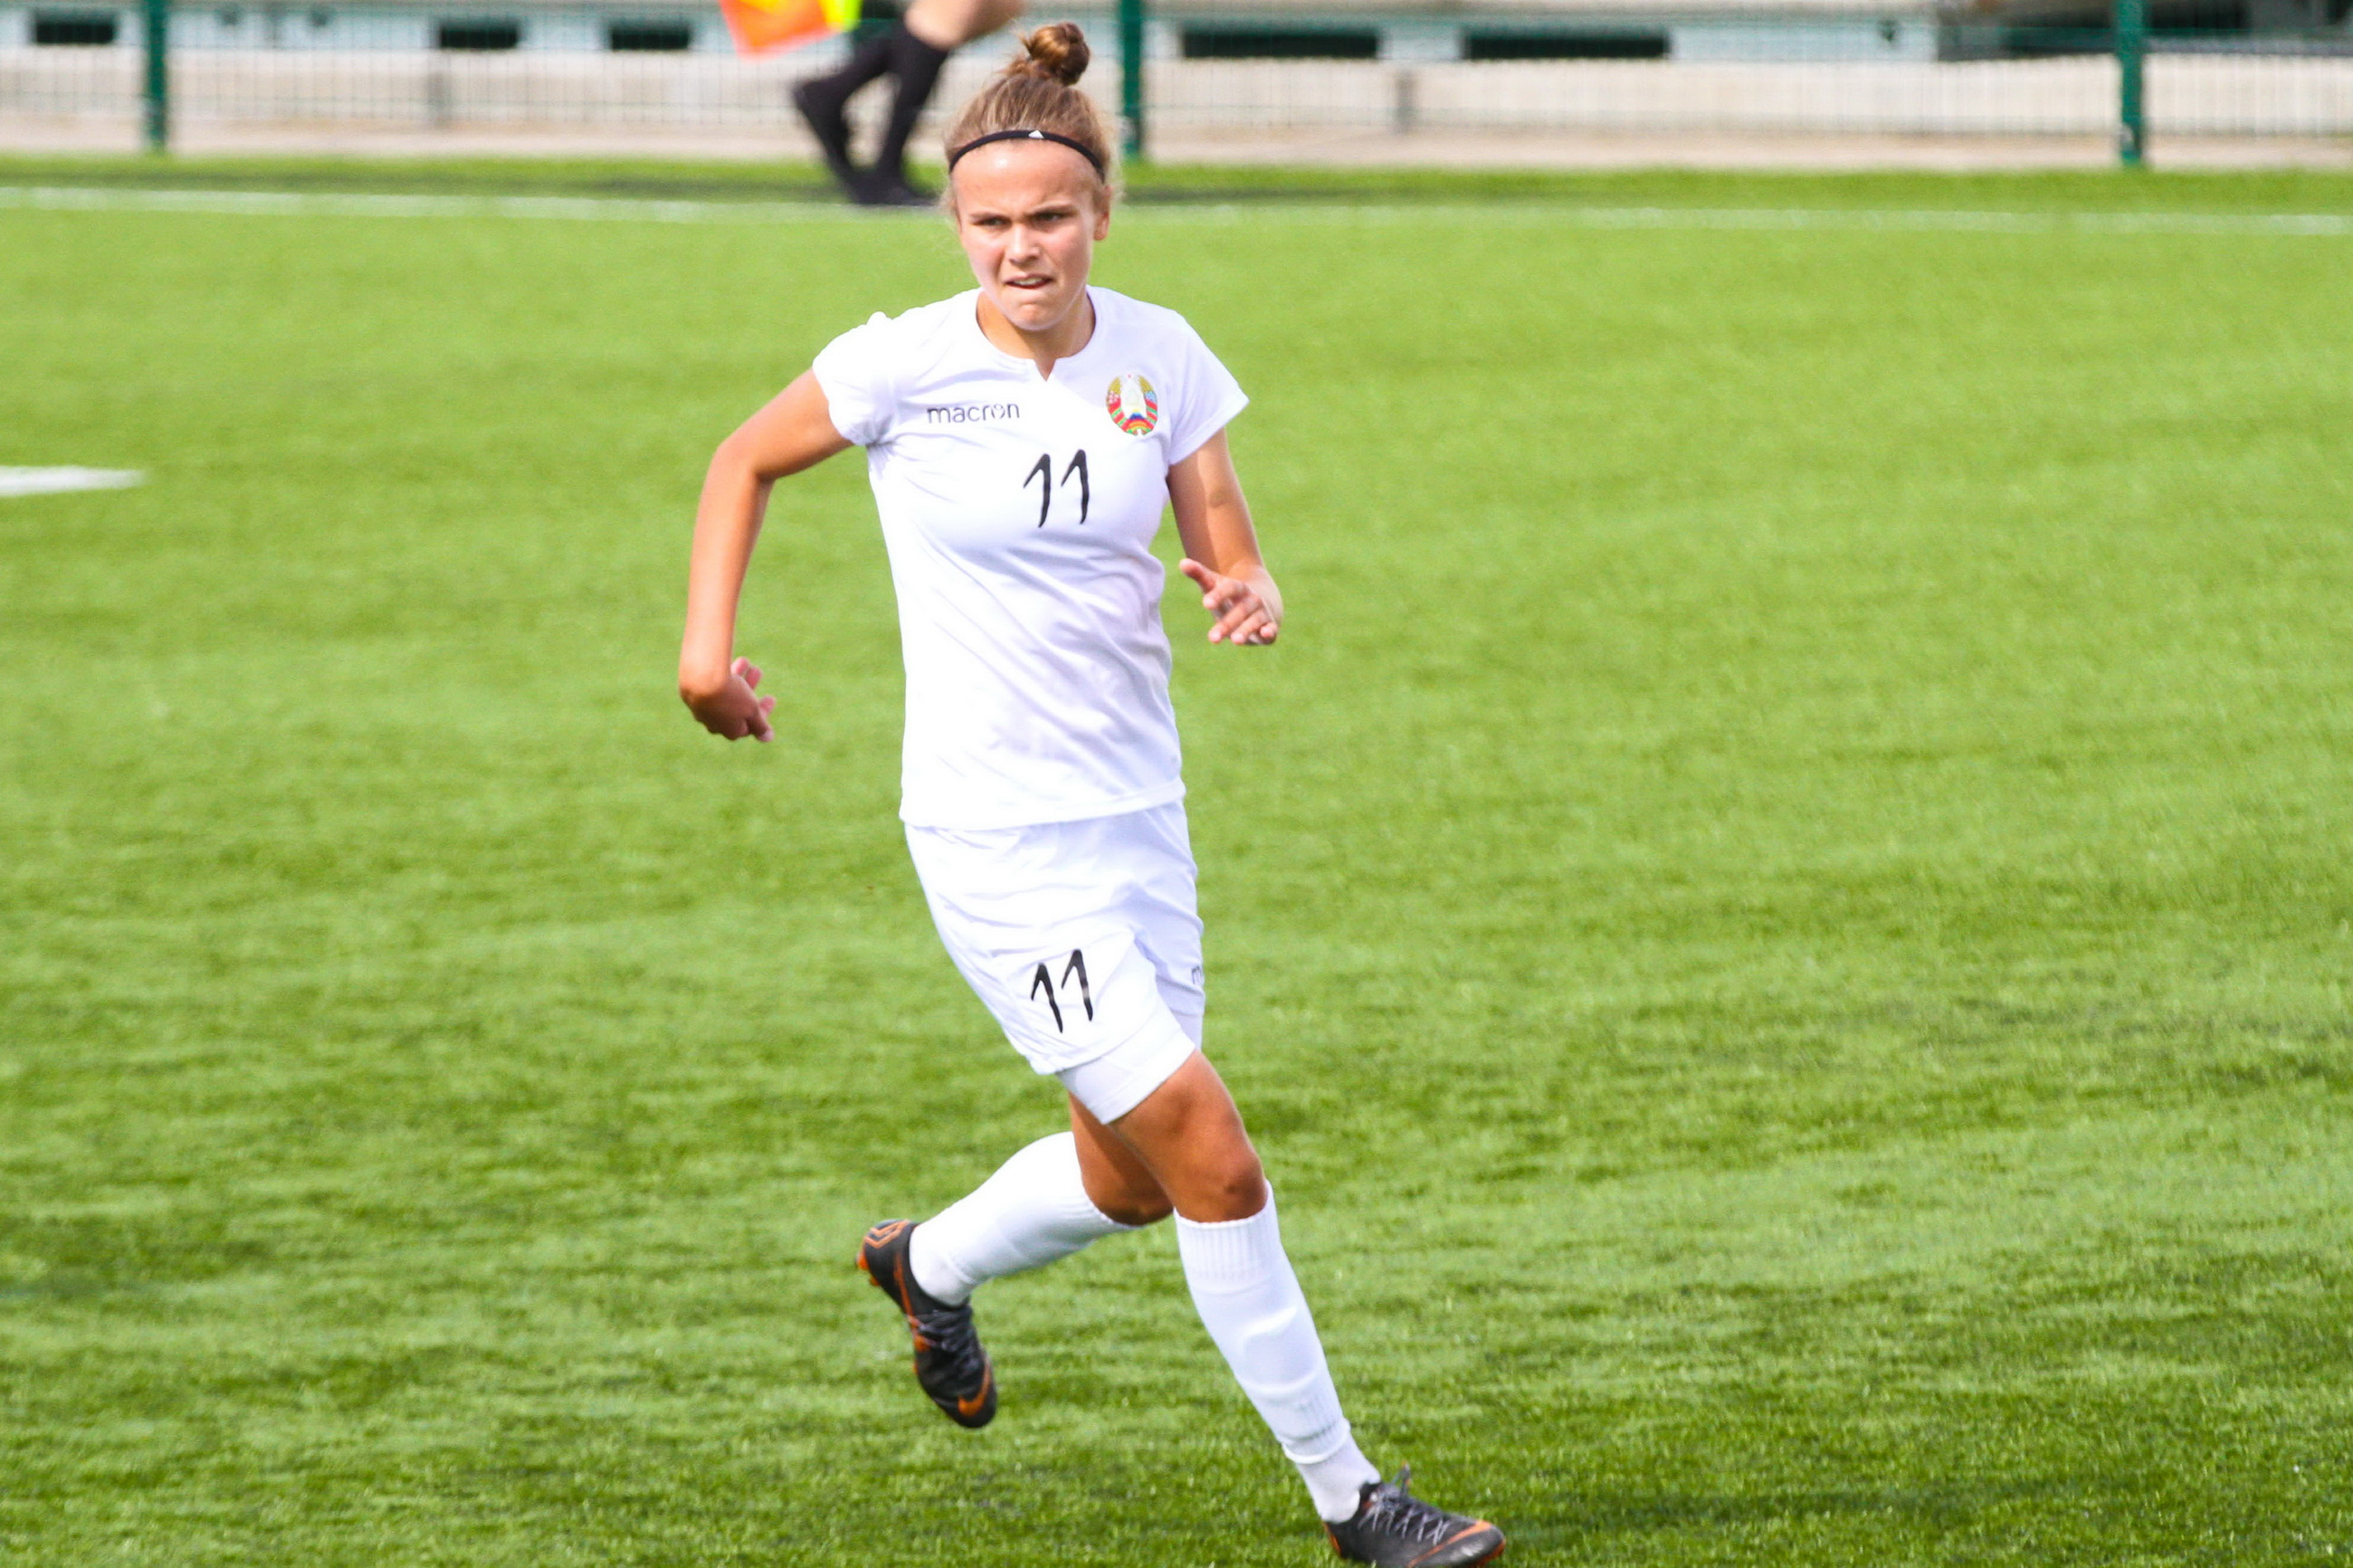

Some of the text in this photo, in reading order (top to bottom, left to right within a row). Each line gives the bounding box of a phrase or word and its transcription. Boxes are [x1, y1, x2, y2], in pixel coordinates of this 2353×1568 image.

[927, 404, 1020, 423] macron
[1024, 450, 1090, 527] 11
[1031, 948, 1093, 1033] 11
